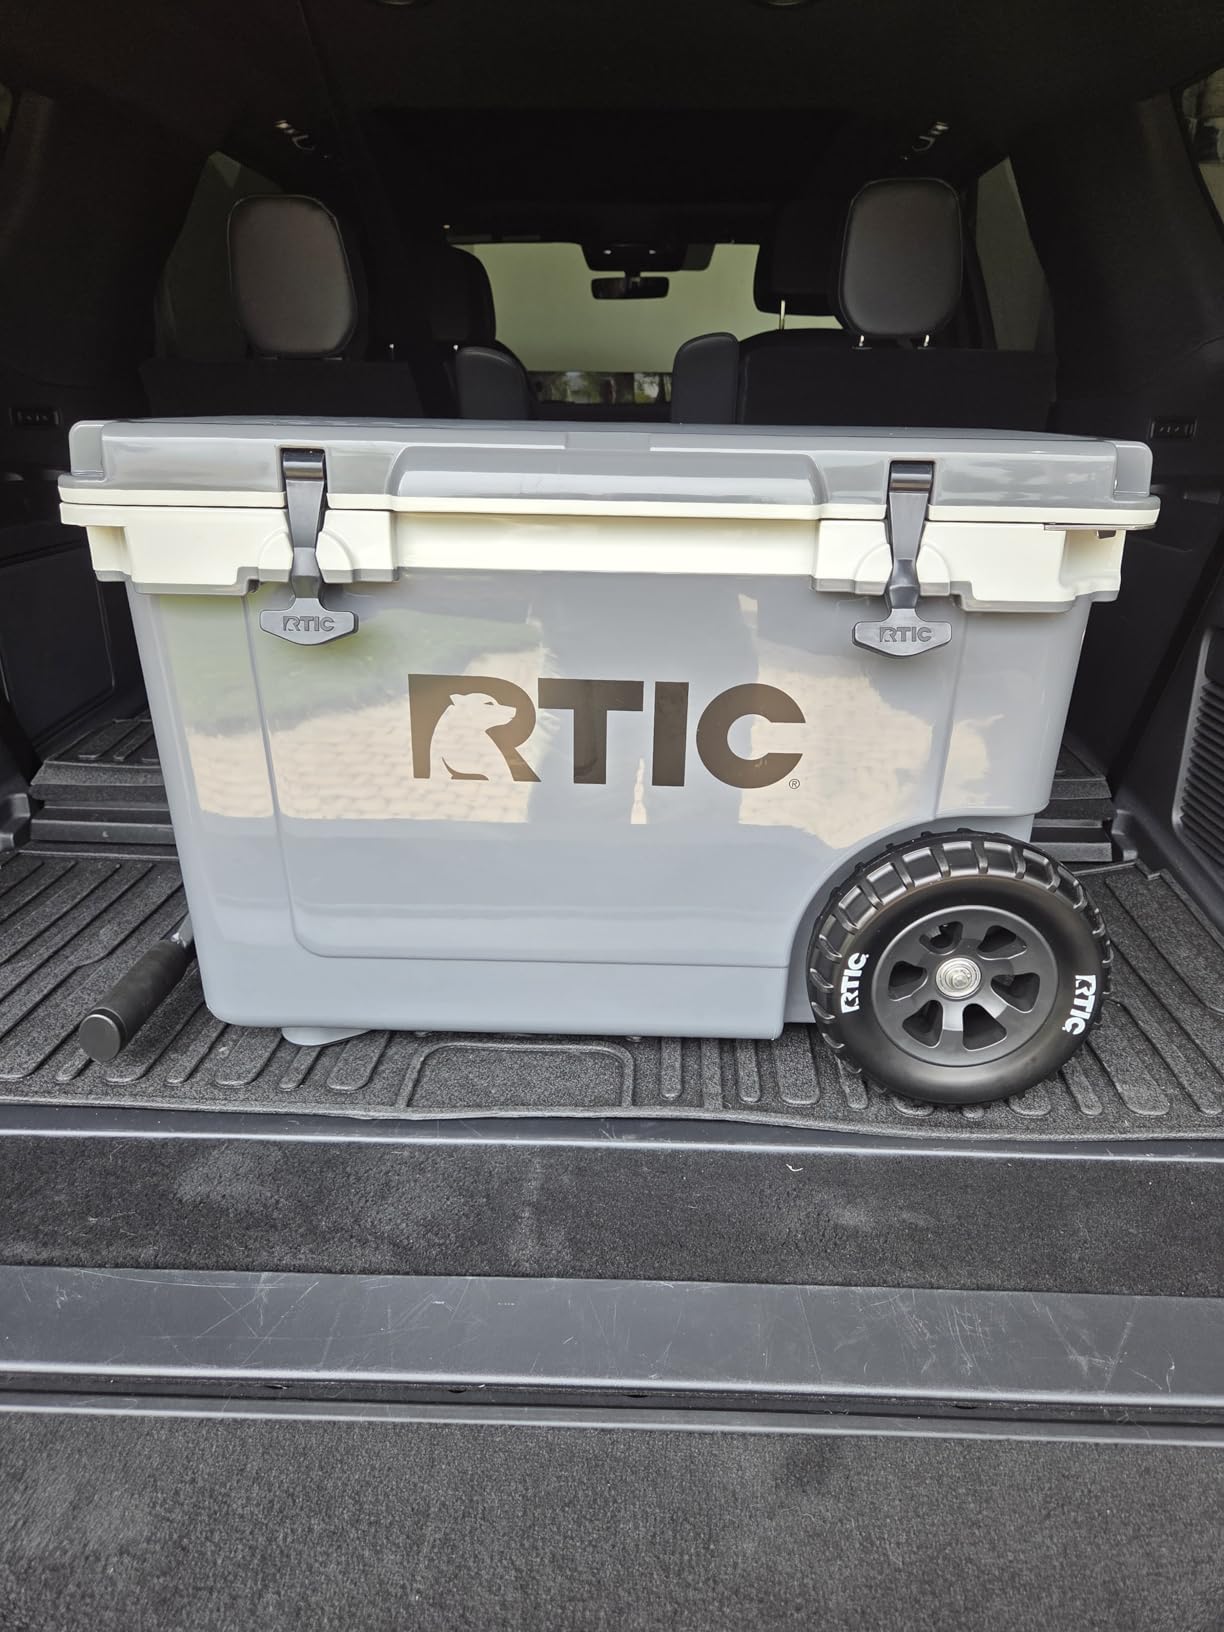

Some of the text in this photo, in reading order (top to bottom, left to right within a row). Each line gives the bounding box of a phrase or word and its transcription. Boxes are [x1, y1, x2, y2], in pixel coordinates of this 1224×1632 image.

[282, 615, 336, 632] RTIC
[879, 626, 933, 643] RTIC
[407, 673, 807, 789] RTIC
[840, 952, 869, 1014] RTIC
[1062, 974, 1097, 1035] RTIC
